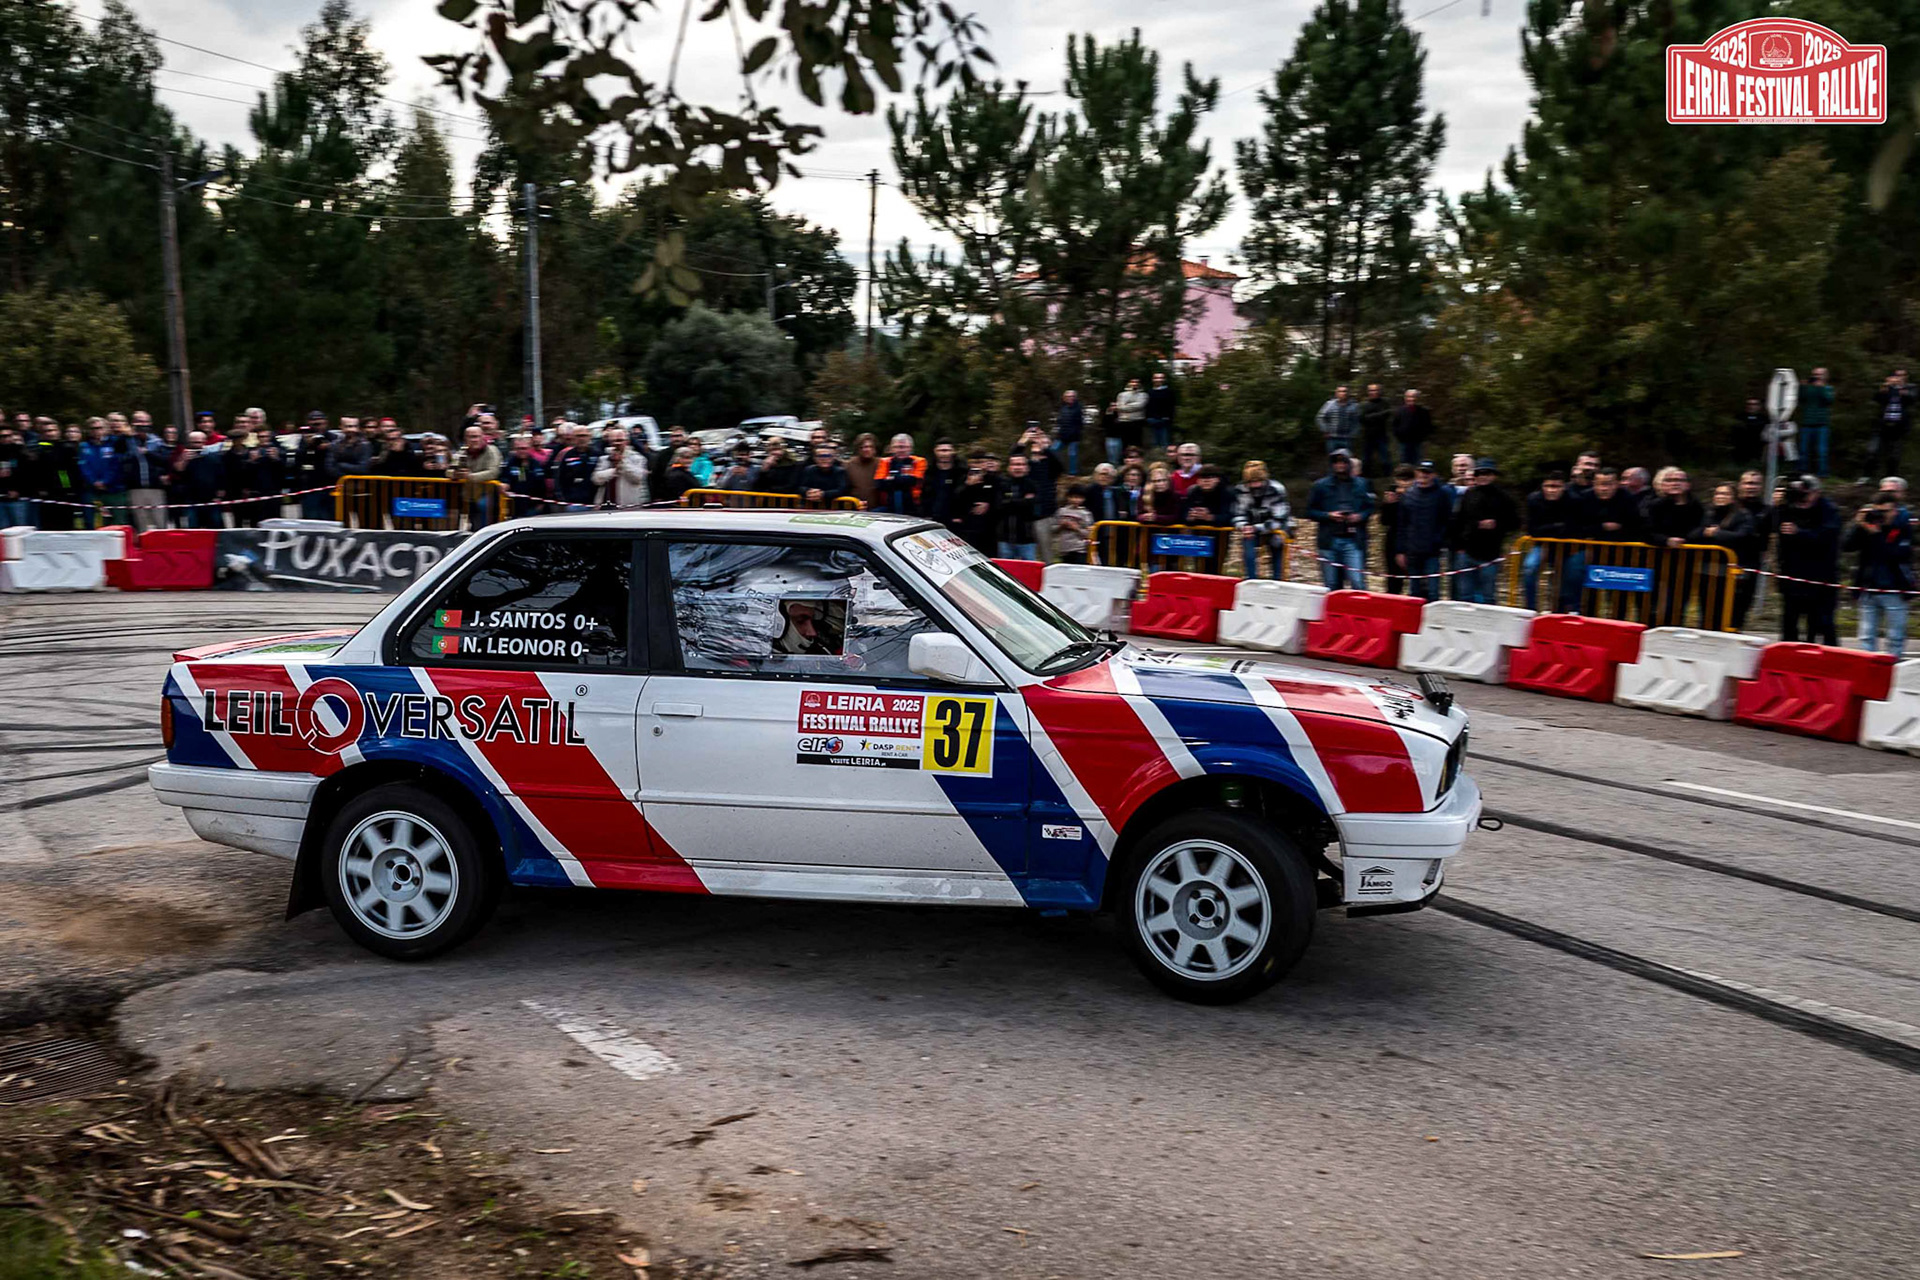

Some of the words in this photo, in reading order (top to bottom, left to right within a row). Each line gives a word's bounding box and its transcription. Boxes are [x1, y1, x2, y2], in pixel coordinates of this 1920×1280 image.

[470, 611, 485, 627] J.
[489, 611, 566, 630] SANTOS
[463, 636, 482, 653] N.
[486, 637, 566, 657] LEONOR
[826, 695, 885, 712] LEIRIA
[891, 699, 920, 712] 2025
[802, 713, 866, 732] FESTIVAL
[868, 717, 919, 734] RALLYE
[933, 699, 987, 768] 37
[798, 738, 826, 752] elf
